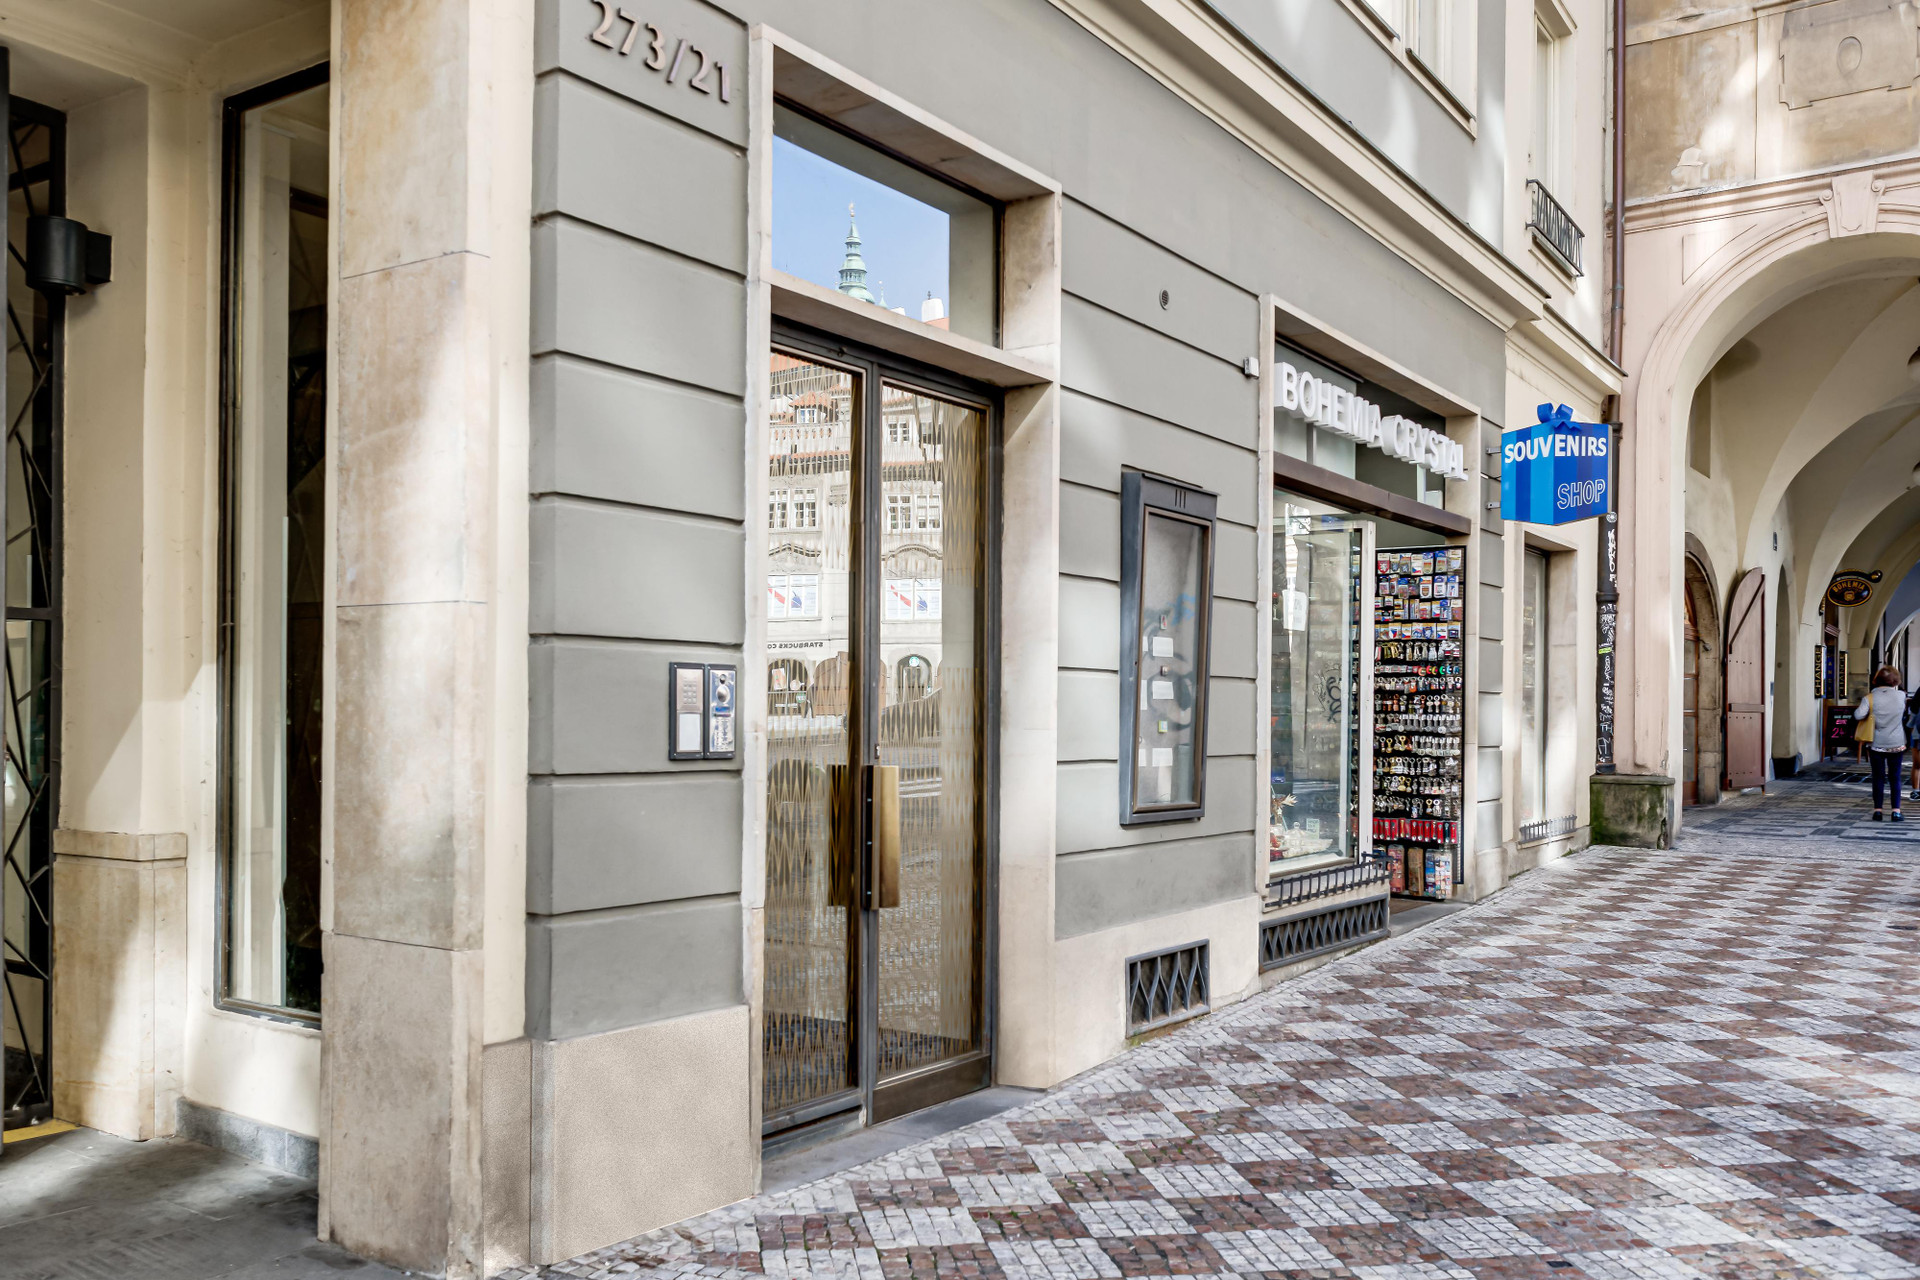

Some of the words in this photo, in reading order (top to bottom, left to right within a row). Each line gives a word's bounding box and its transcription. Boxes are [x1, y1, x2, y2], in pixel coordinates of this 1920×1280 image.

[591, 0, 730, 104] 273/21
[1274, 362, 1384, 449] BOHEMIA
[1382, 414, 1469, 482] CRYSTAL
[1504, 433, 1607, 464] SOUVENIRS
[1557, 479, 1606, 511] SHOP
[1832, 580, 1866, 593] BOHEMIA
